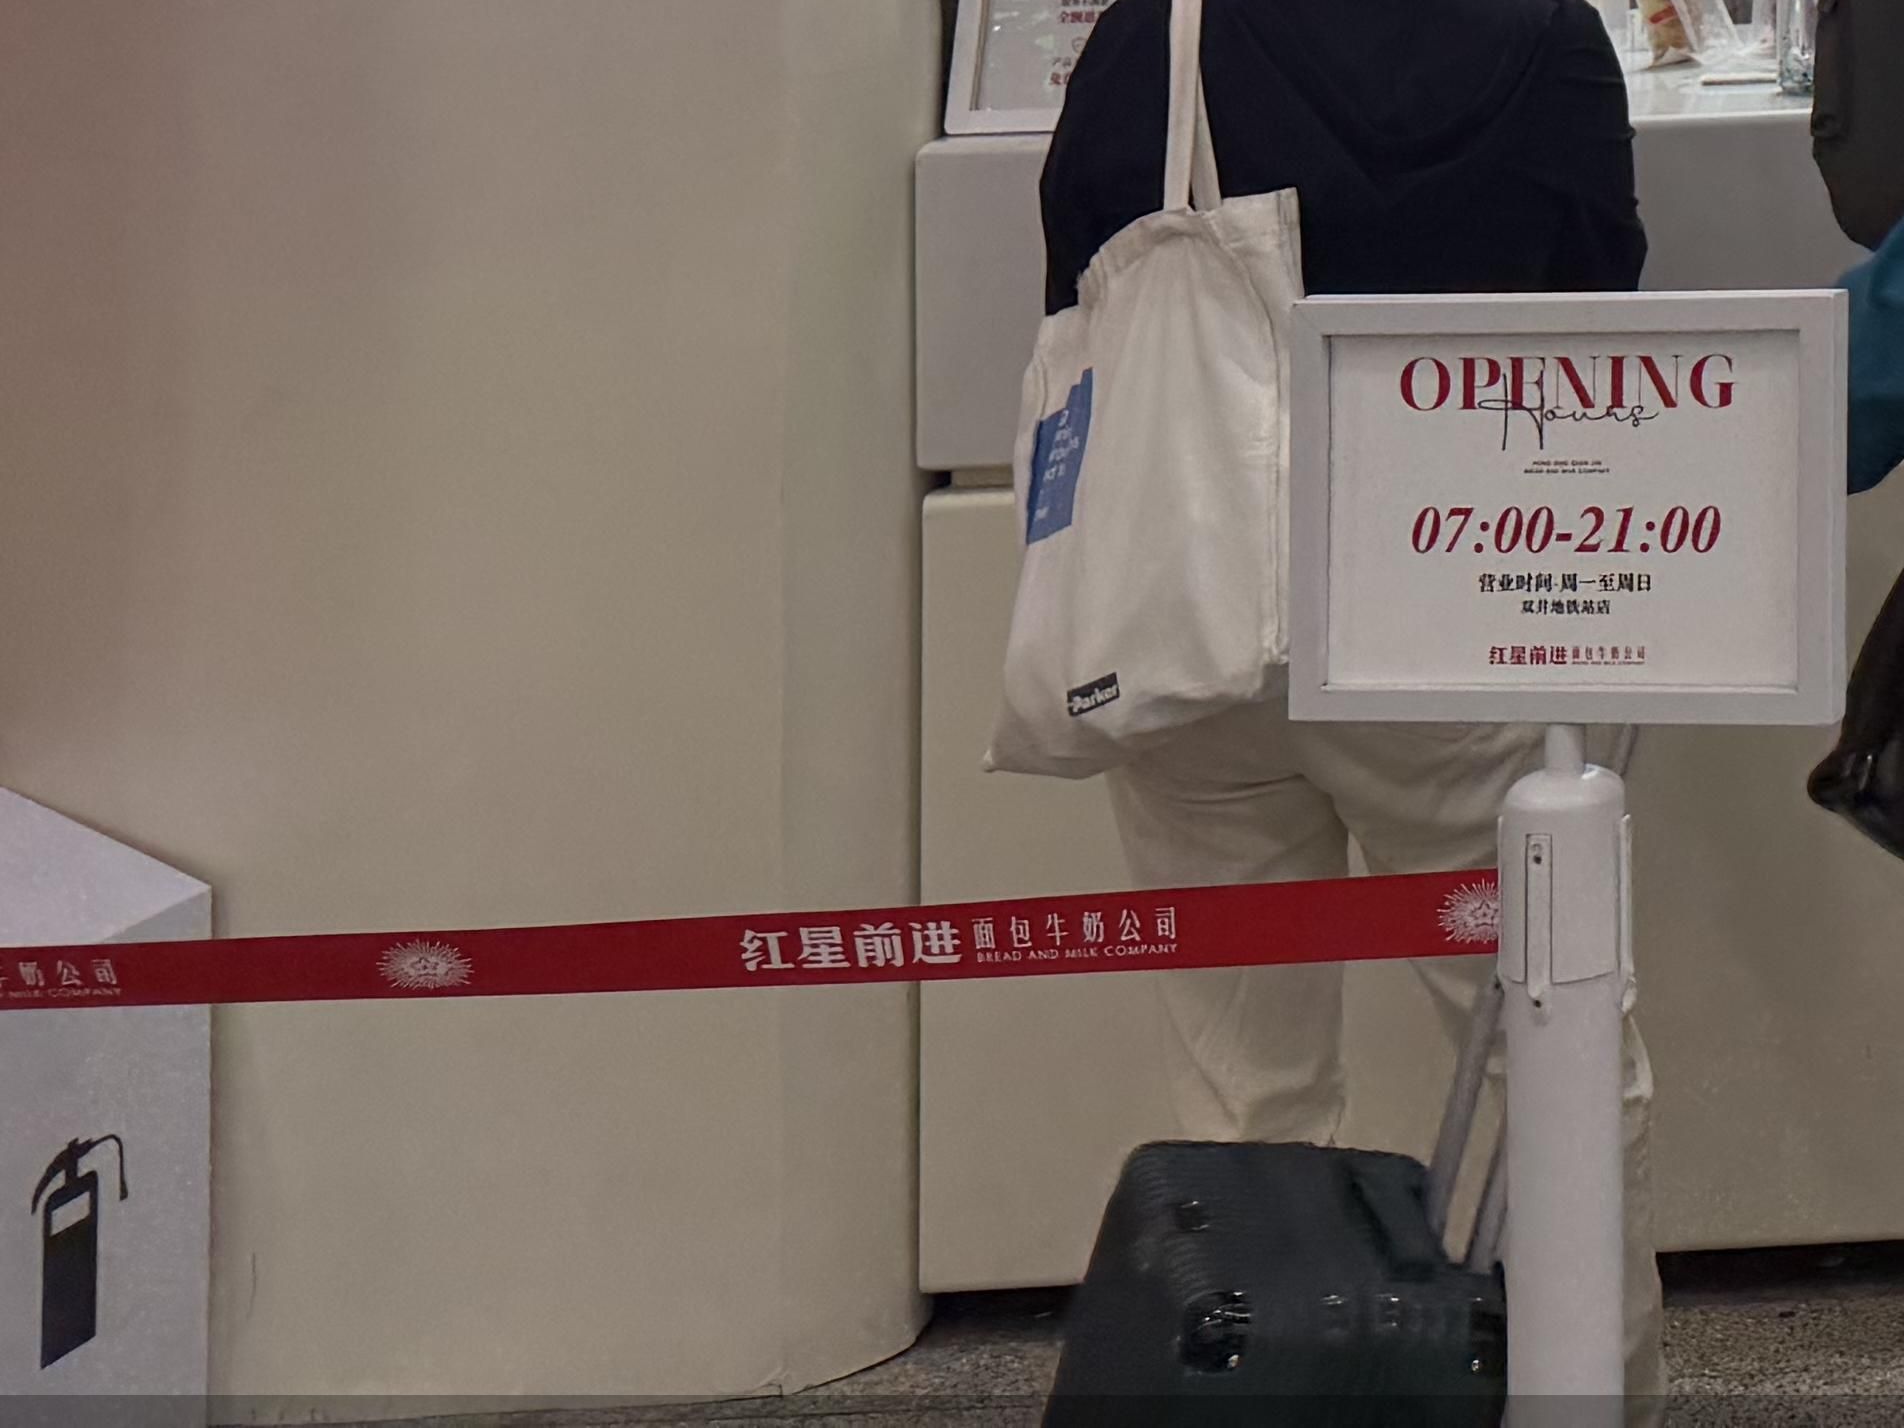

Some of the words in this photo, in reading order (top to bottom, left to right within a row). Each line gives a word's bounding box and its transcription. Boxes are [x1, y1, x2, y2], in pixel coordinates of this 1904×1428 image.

[1060, 12, 1102, 24] 全额退
[1399, 353, 1735, 412] OPENING
[1478, 372, 1659, 452] Hours
[1412, 505, 1721, 554] 07:00-21:00
[1522, 599, 1611, 615] 双井地铁站店
[1489, 646, 1567, 665] 红星前进
[739, 920, 961, 971] 红星前进
[972, 906, 1177, 950] 面包牛奶公司
[976, 949, 1022, 963] BREAD
[1027, 948, 1059, 961] AND
[1064, 945, 1098, 960] MILK
[1104, 943, 1177, 957] COMPANY
[0, 959, 117, 986] 奶公司
